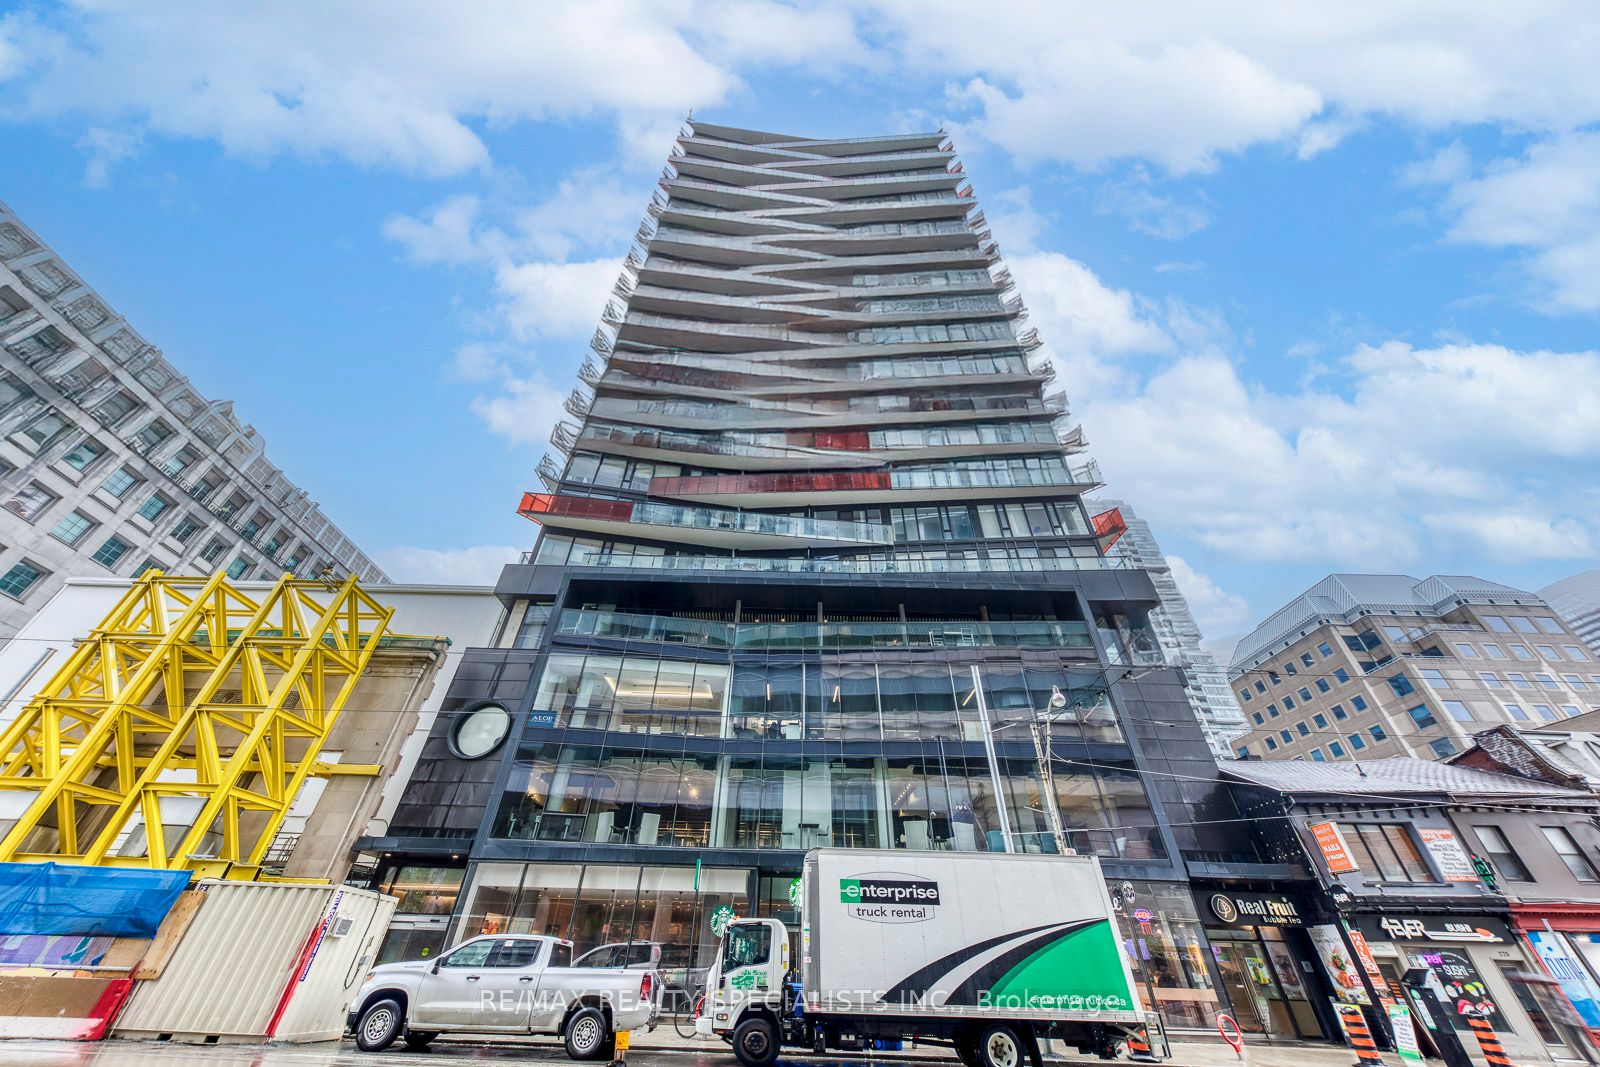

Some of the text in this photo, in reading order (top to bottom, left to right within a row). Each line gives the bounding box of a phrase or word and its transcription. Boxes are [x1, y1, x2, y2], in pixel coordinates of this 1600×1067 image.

[842, 885, 938, 901] enterprise
[856, 906, 926, 918] truck rental
[1236, 896, 1299, 916] Real Fruit
[1263, 915, 1302, 924] Bubble Tea
[1444, 923, 1473, 933] SUSHI
[1444, 964, 1470, 977] SUSHI
